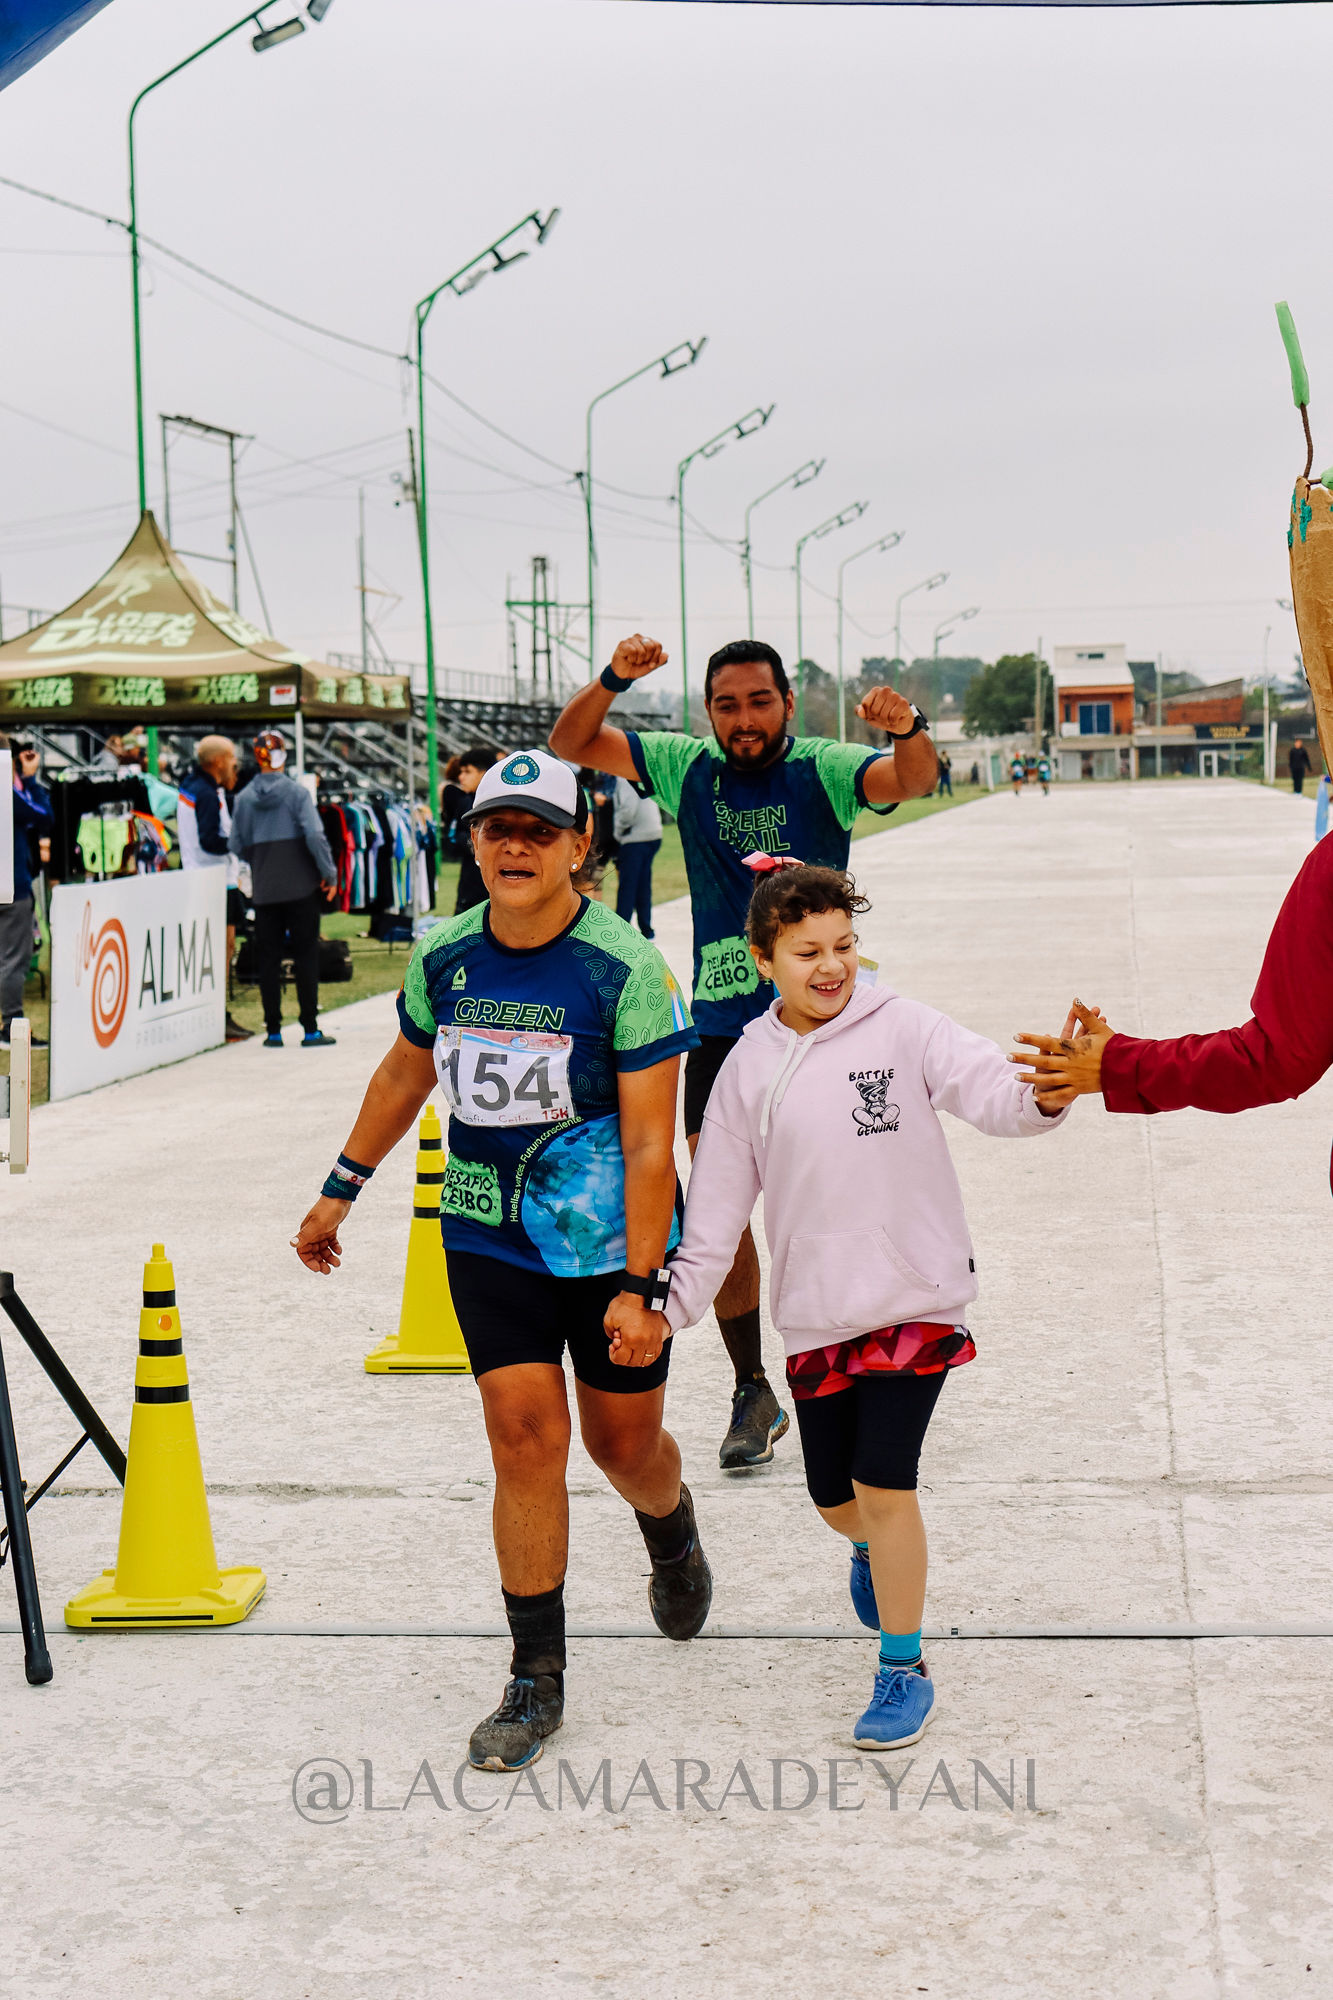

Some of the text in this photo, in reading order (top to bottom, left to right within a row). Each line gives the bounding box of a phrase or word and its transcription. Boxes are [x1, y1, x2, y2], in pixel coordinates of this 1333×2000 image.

[138, 917, 215, 1009] ALMA
[454, 997, 565, 1030] GREEN
[441, 1048, 559, 1111] 154
[849, 1069, 894, 1081] BATTLE
[857, 1121, 900, 1136] GENUINE
[509, 1188, 521, 1222] Huellas
